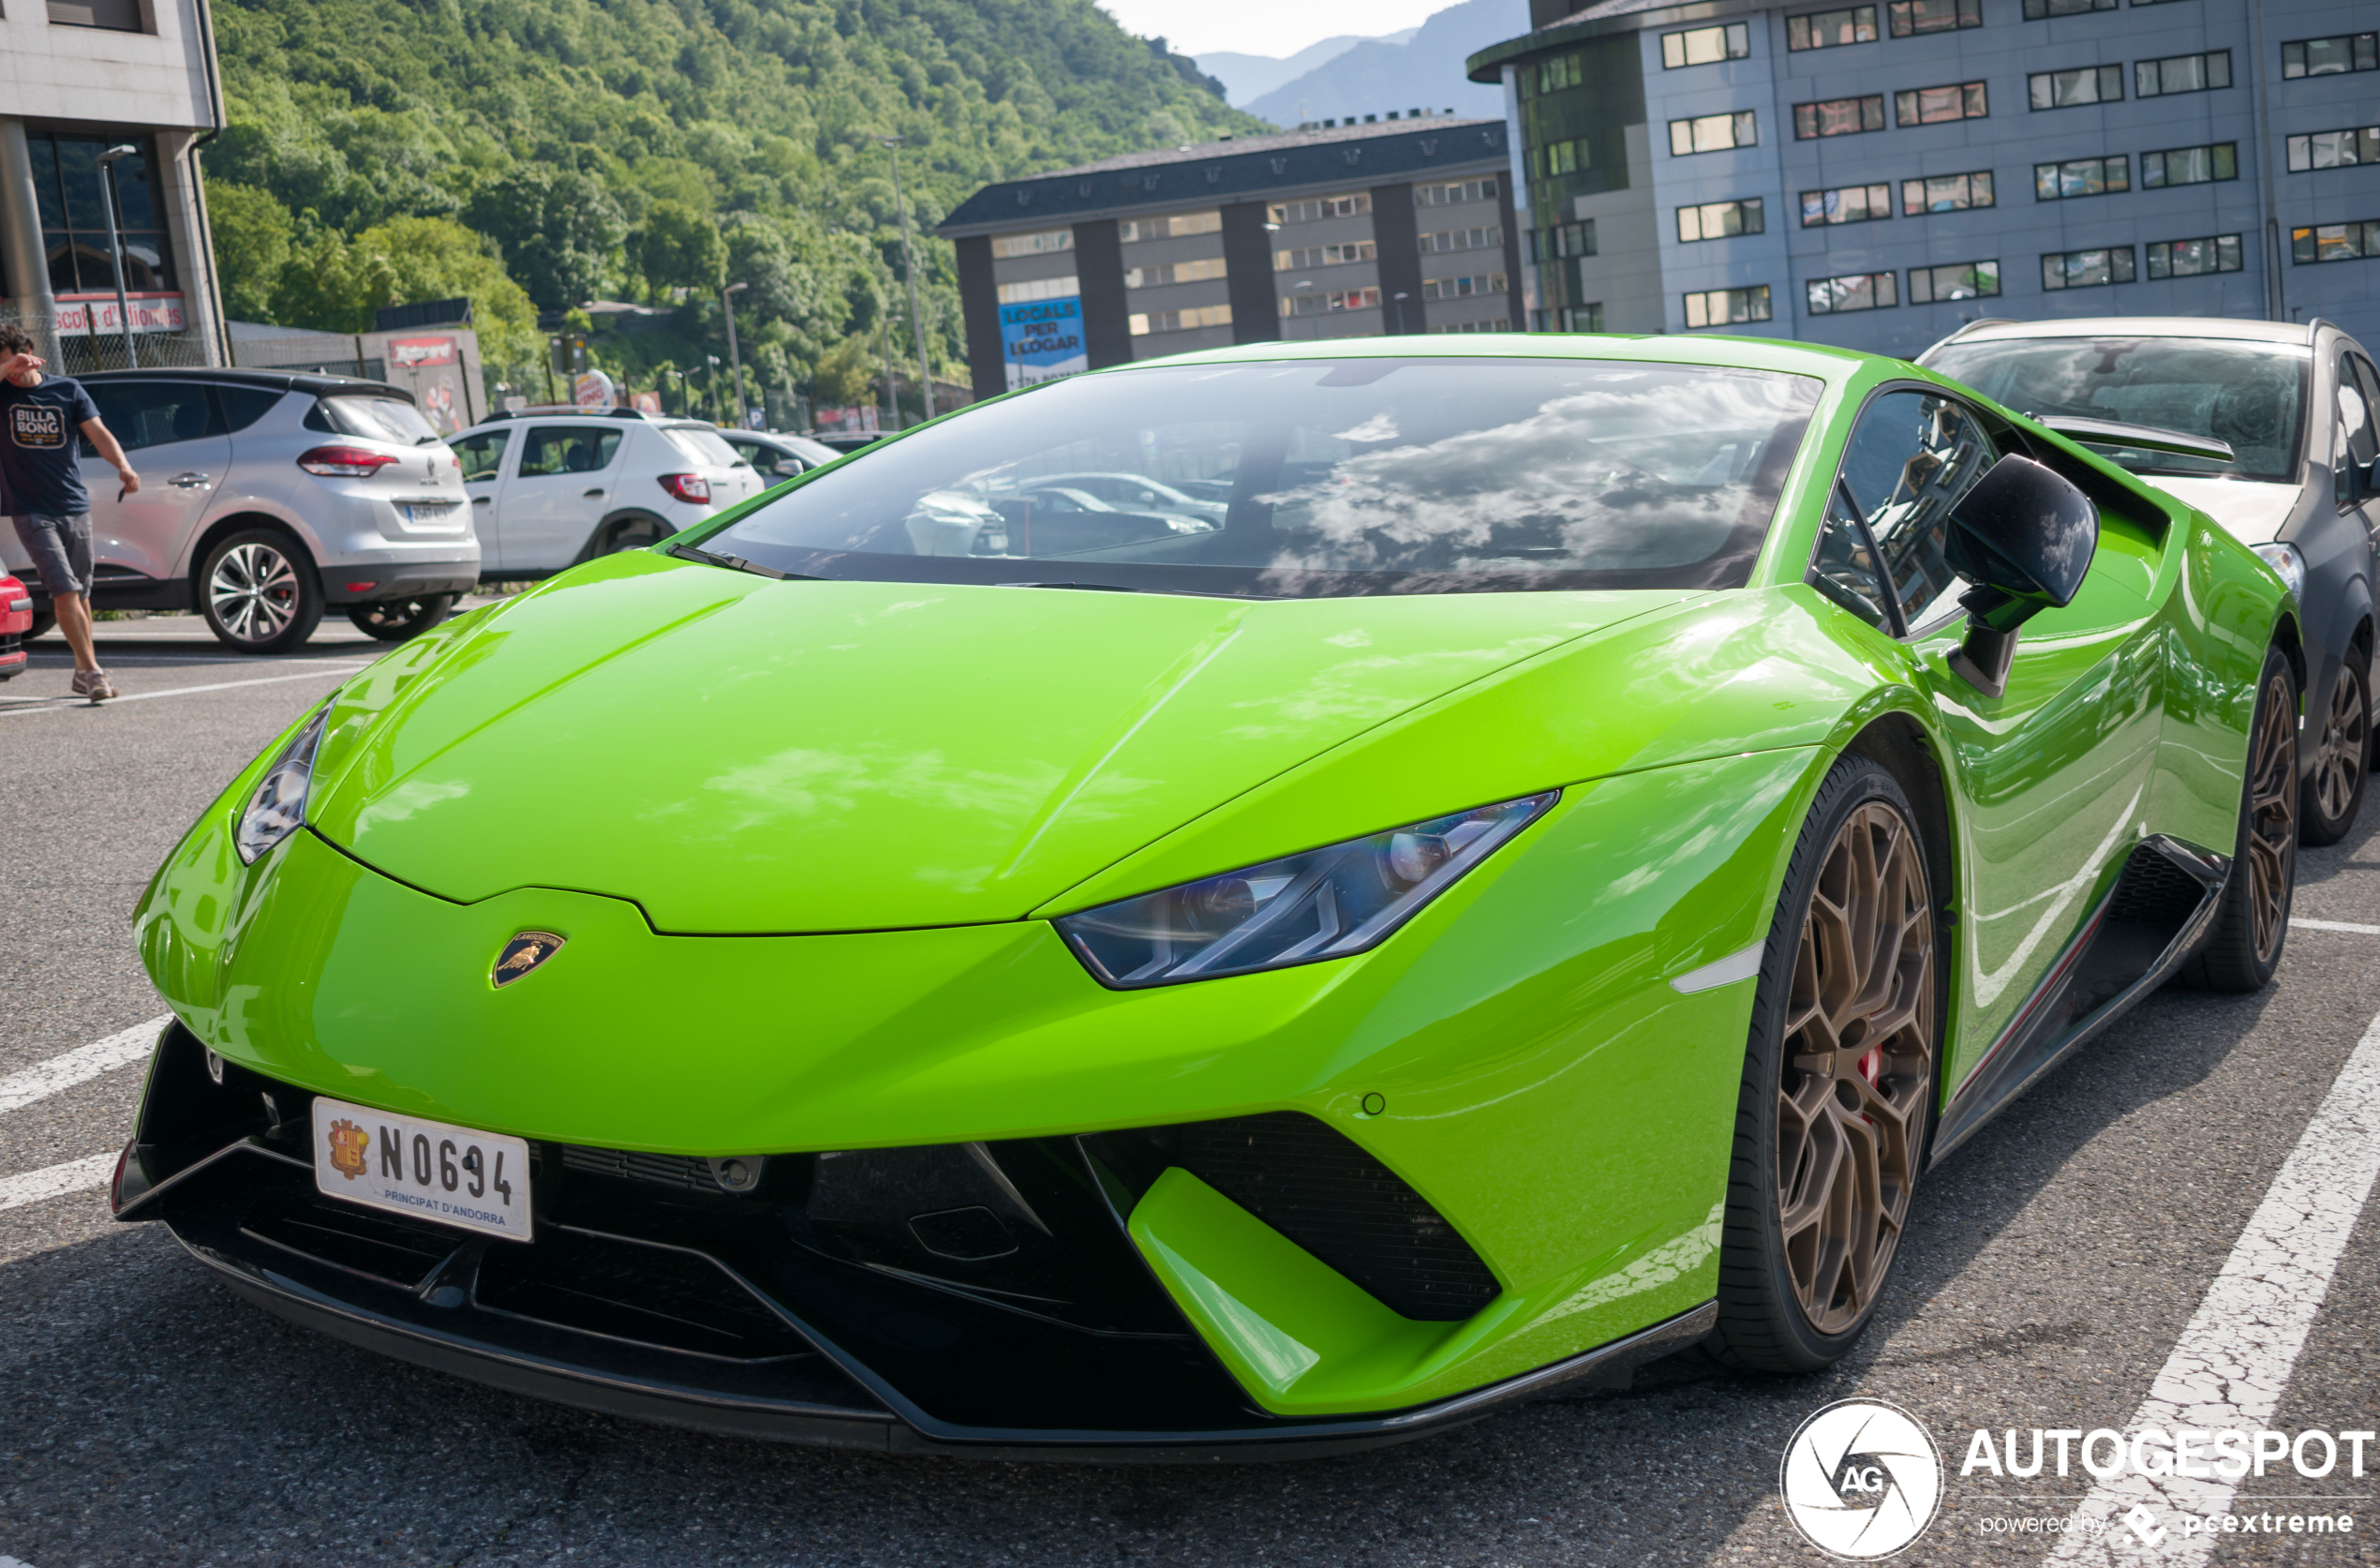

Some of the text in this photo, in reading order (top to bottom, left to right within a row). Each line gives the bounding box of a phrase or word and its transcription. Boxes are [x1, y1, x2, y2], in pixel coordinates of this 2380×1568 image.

[1006, 304, 1076, 323] LOCALS
[1024, 321, 1058, 337] PER
[1010, 336, 1079, 355] LLOGAR
[17, 409, 57, 422] BILLA
[751, 411, 762, 426] P
[17, 421, 59, 433] BONG
[514, 933, 561, 948] LAMBORGHINI
[379, 1125, 512, 1206] N0694
[384, 1189, 506, 1226] PRINCIPAT D'ANDORRA
